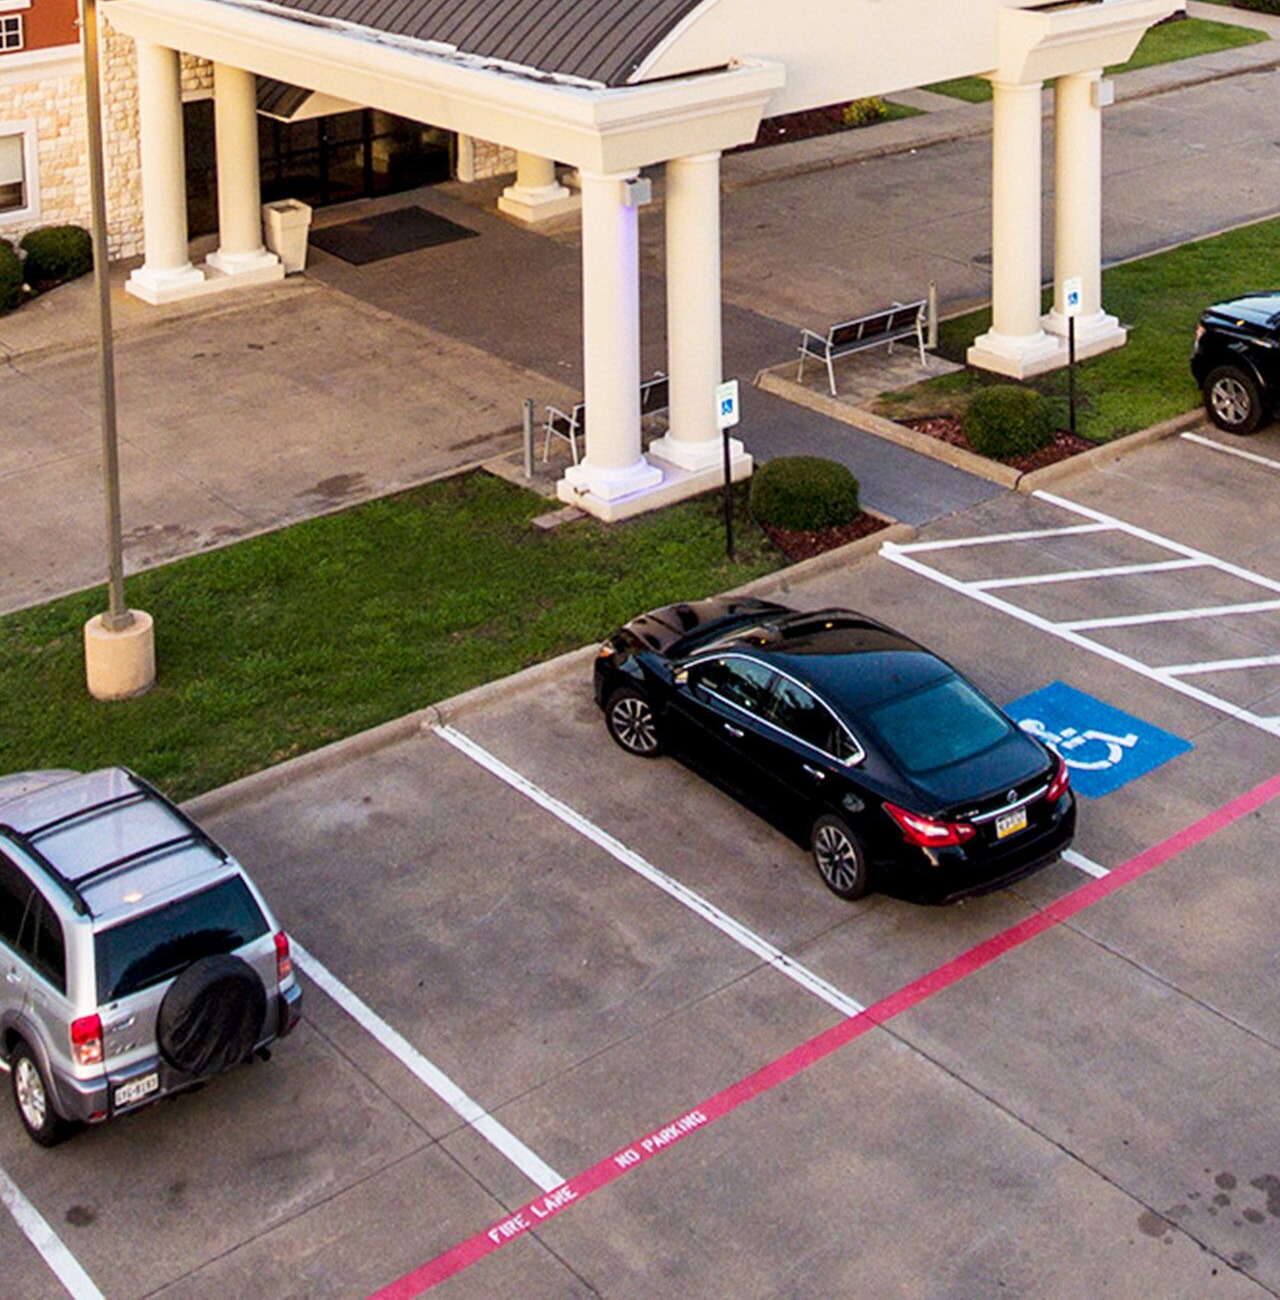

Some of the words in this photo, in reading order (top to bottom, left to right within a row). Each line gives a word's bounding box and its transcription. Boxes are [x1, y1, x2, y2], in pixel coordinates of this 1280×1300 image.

[488, 1213, 531, 1244] FIRE
[531, 1185, 578, 1218] LANE
[614, 1150, 641, 1169] NO
[641, 1110, 707, 1153] PARKING
